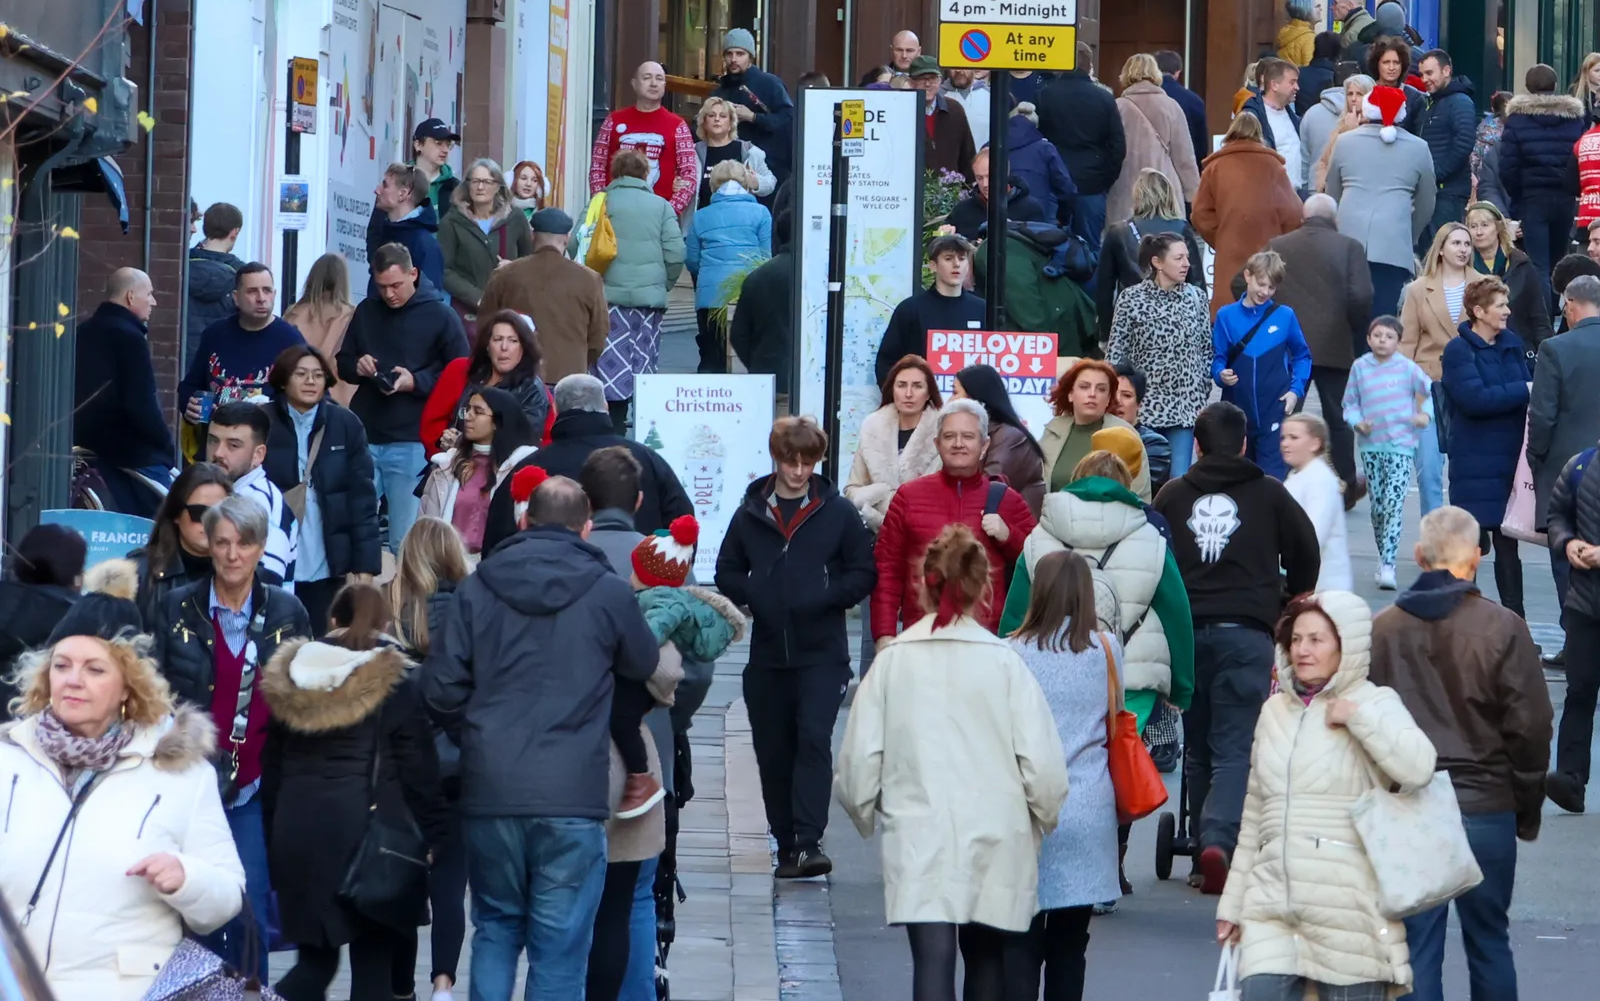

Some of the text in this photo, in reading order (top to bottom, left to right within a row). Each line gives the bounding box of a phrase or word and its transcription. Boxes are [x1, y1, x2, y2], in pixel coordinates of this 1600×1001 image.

[949, 1, 960, 14] 4
[963, 5, 986, 17] pm
[1000, 3, 1067, 19] Midnight
[1005, 32, 1055, 48] At any
[1013, 49, 1047, 62] time
[931, 332, 1053, 355] PRELOVED
[963, 353, 1020, 374] KILO
[676, 386, 733, 398] Pret into
[665, 399, 743, 413] Christmas
[694, 475, 713, 505] PRET
[91, 531, 149, 545] FRANCIS
